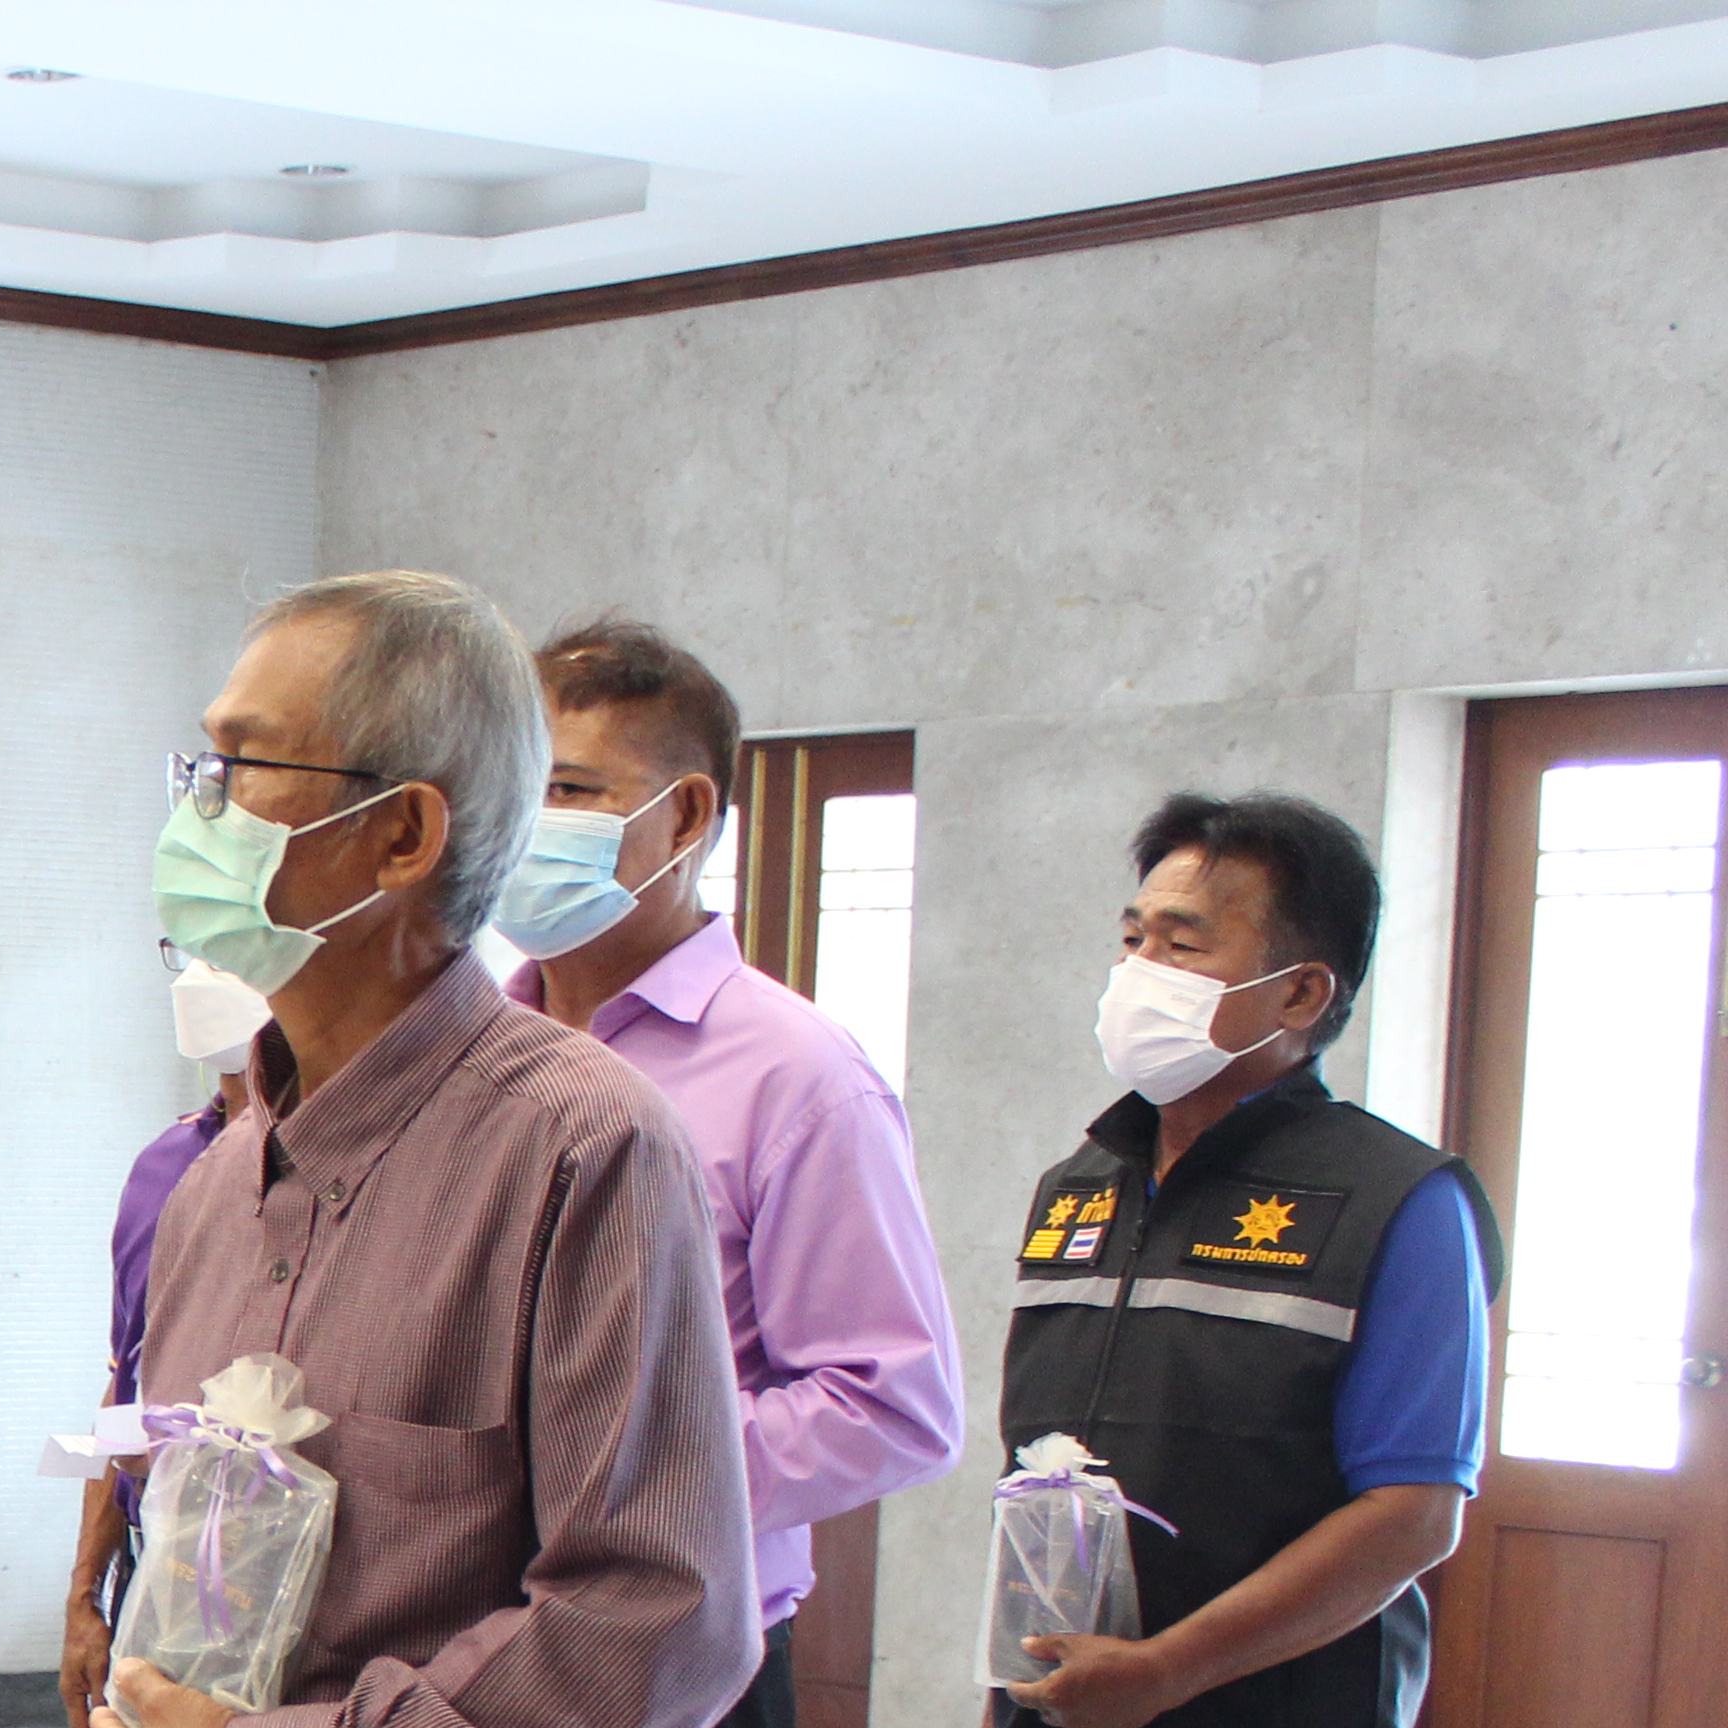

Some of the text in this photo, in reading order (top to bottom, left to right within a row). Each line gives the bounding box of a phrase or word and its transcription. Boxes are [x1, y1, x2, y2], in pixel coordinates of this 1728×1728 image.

[1191, 1243, 1309, 1266] กรมการปกครอง
